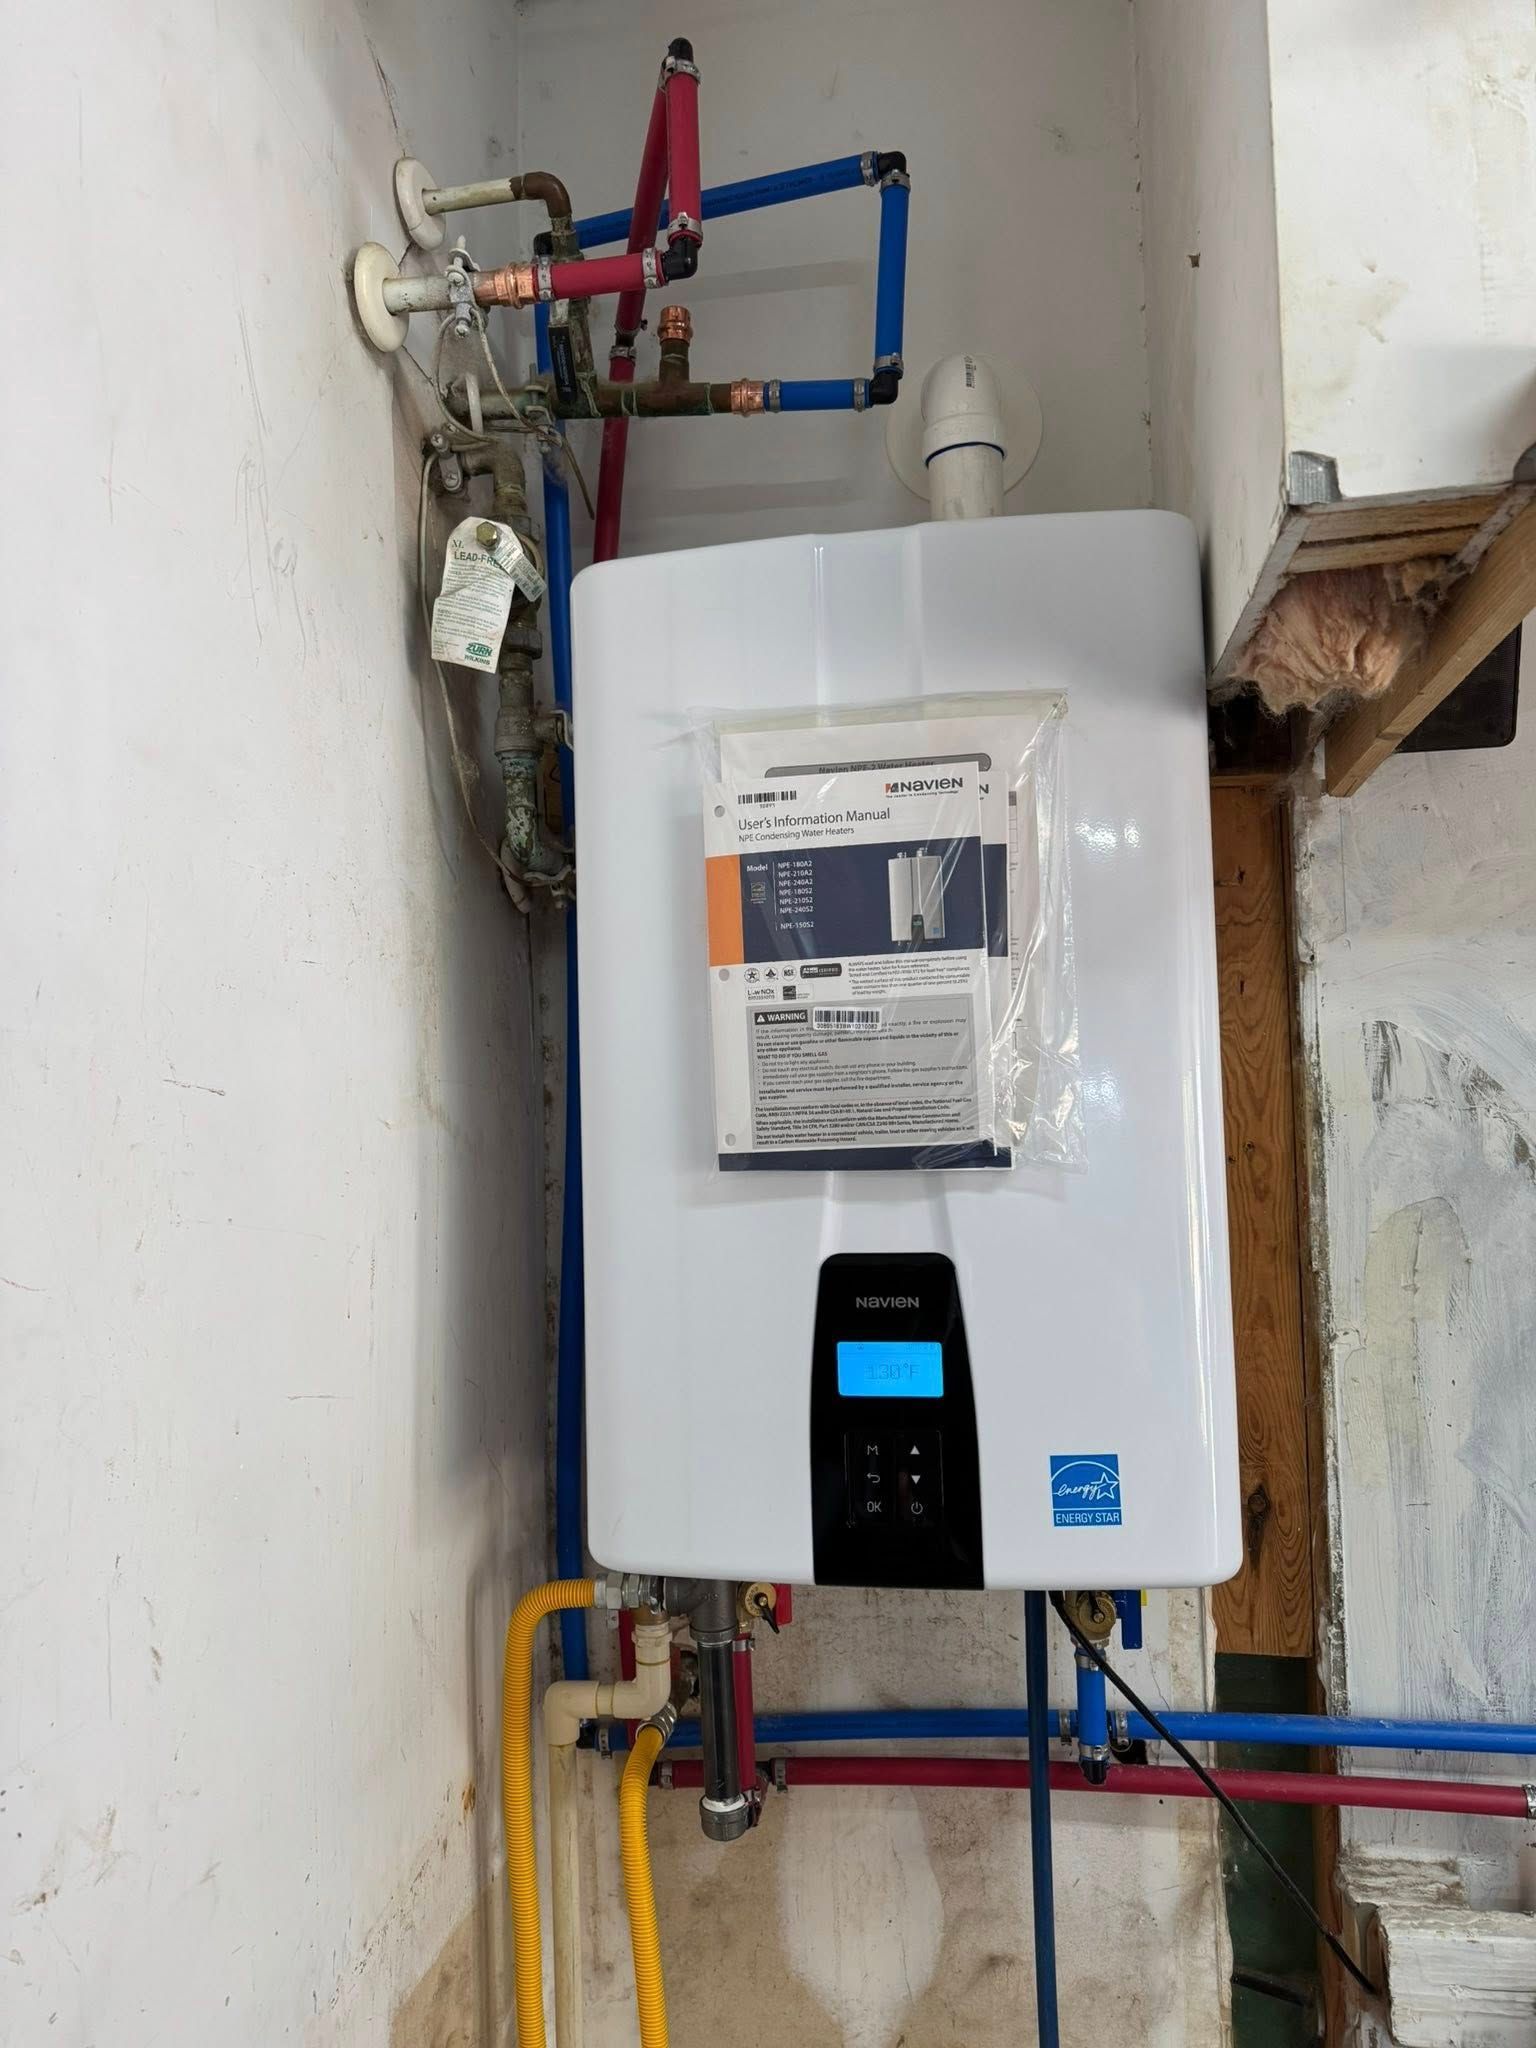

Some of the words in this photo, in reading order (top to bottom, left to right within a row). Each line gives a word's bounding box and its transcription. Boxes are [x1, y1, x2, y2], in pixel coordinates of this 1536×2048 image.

[466, 643, 492, 657] ZURN
[739, 817, 771, 830] User's
[774, 813, 843, 827] Information
[846, 808, 890, 822] Manual
[755, 829, 800, 841] Condensing
[802, 828, 823, 837] Water
[825, 827, 854, 836] Heaters
[746, 864, 768, 872] Model
[767, 1012, 805, 1021] WARNING
[867, 1444, 879, 1455] M
[1057, 1484, 1099, 1500] energy
[867, 1501, 882, 1512] OK
[1056, 1513, 1093, 1524] ENERGY
[1095, 1512, 1120, 1523] STAR
